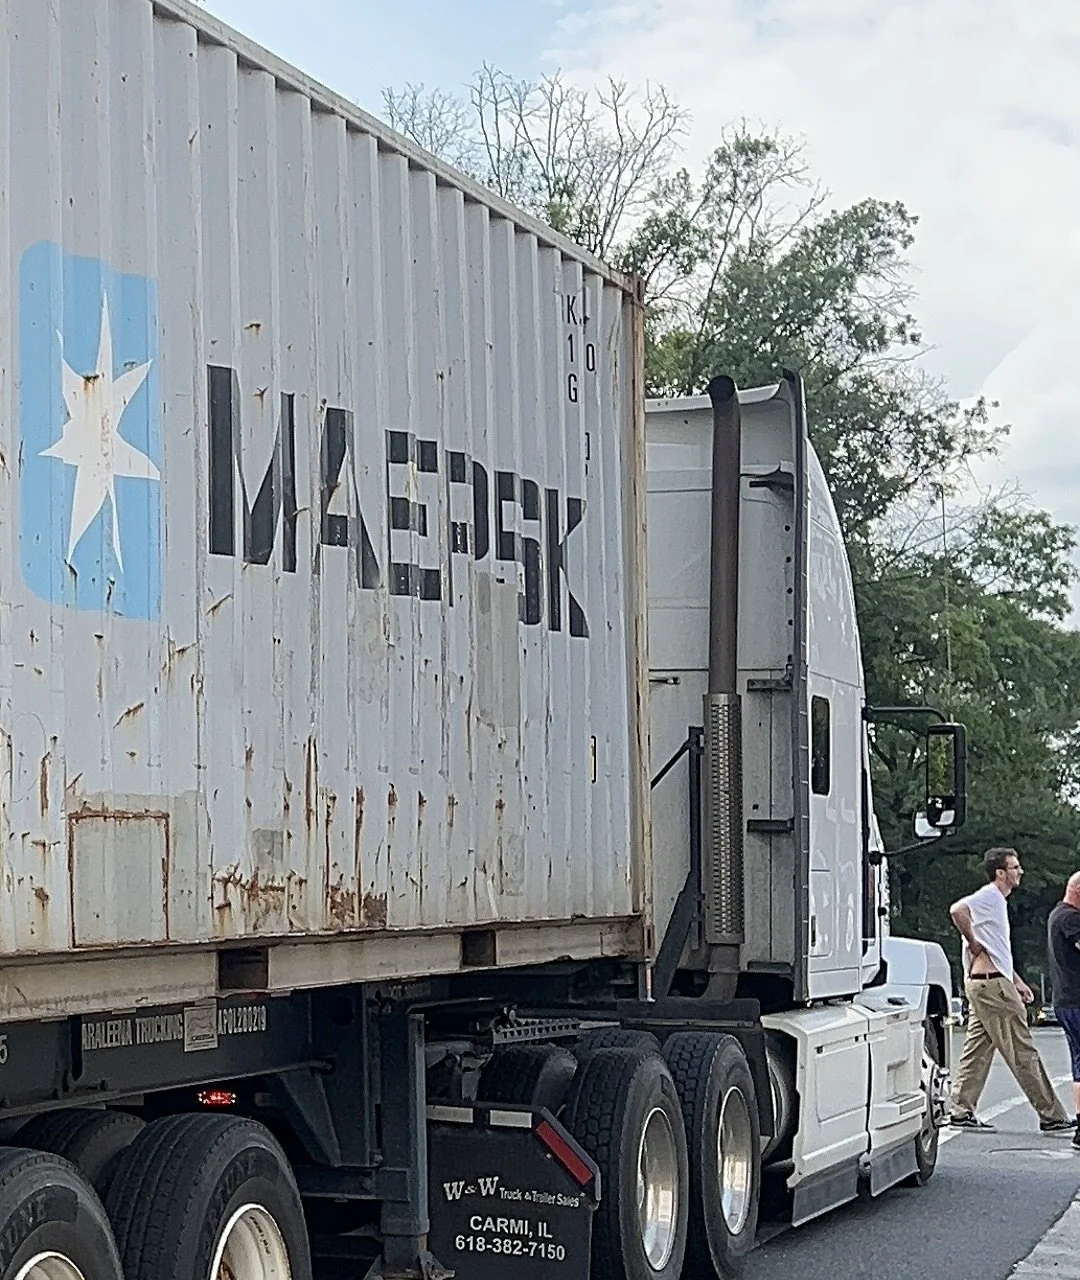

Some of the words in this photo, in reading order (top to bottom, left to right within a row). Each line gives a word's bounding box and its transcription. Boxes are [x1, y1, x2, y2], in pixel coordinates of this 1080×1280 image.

[470, 1216, 533, 1239] CARMI,
[538, 1222, 553, 1239] IL
[455, 1235, 566, 1261] 618-382-7150
